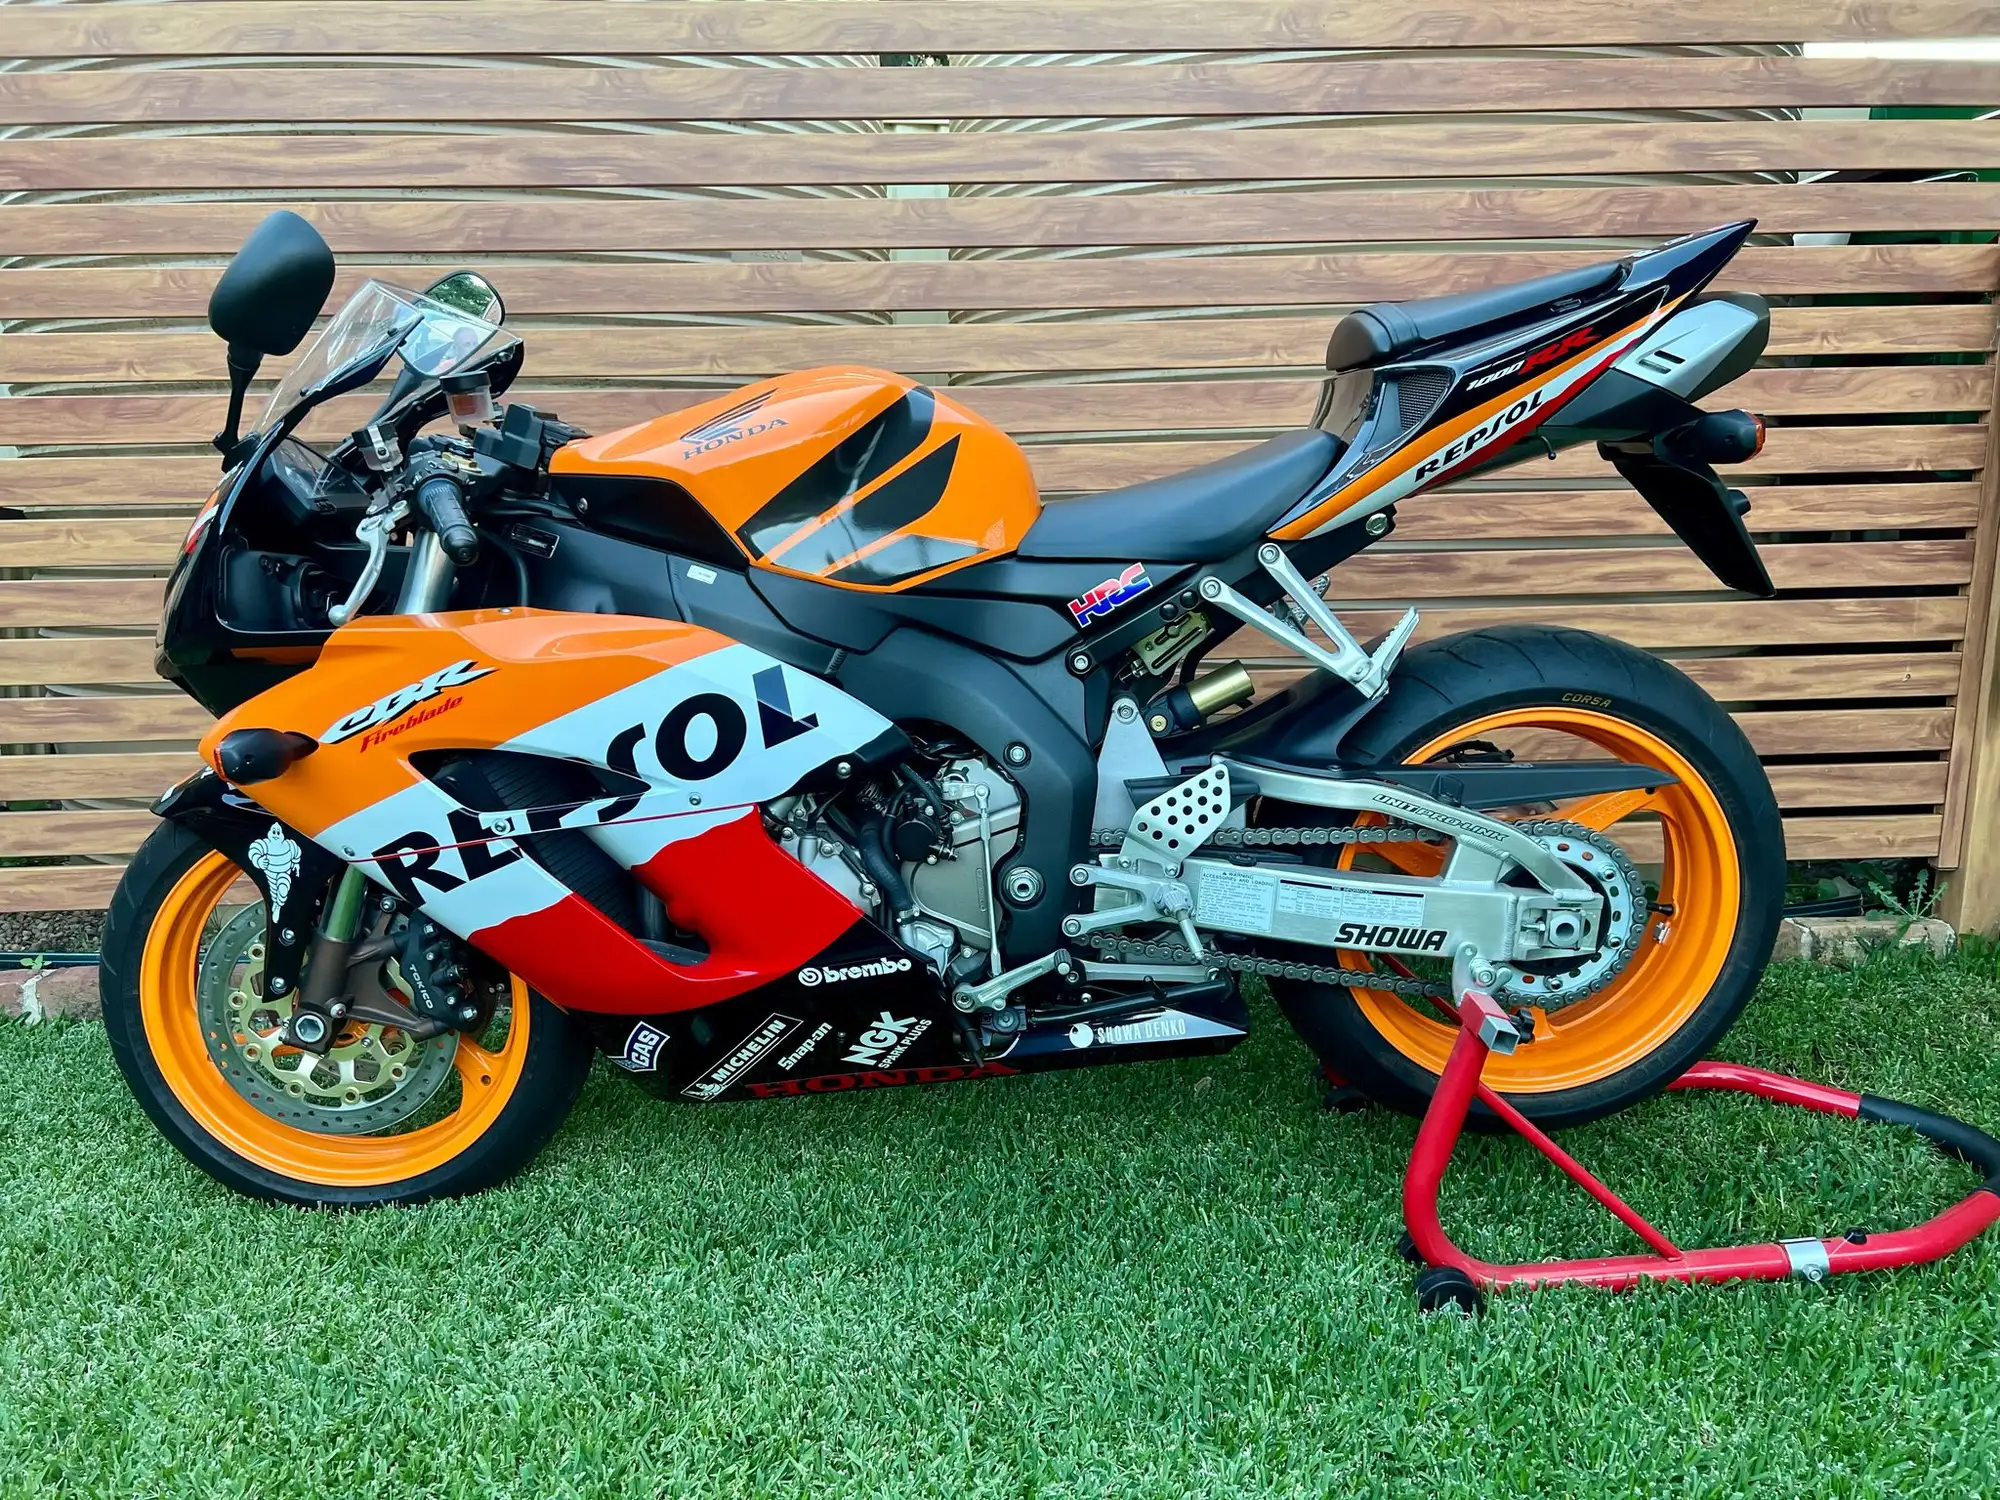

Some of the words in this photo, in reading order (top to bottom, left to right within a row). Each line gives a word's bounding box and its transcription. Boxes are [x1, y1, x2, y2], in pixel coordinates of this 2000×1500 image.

[683, 418, 790, 460] HONDA
[1415, 389, 1544, 482] REPSOL
[1067, 561, 1153, 629] HRC
[318, 659, 501, 745] CBR
[360, 696, 463, 753] Fireblade
[1562, 692, 1612, 708] CORSA
[1372, 793, 1421, 813] UNIT
[1415, 807, 1509, 842] PRO-LINK
[1333, 923, 1448, 951] SHOWA
[409, 963, 434, 1009] TOKICO
[822, 957, 912, 984] brembo
[631, 1030, 660, 1067] GAS
[711, 1019, 787, 1082] MICHELIN
[777, 1022, 833, 1071] Snap-on
[840, 1011, 918, 1066] NGK
[878, 1044, 908, 1069] SPARK
[903, 1019, 933, 1046] PLUGS
[1097, 1023, 1142, 1045] SHOWA
[1145, 1018, 1187, 1039] DENKO
[746, 1062, 1021, 1098] HONDA
